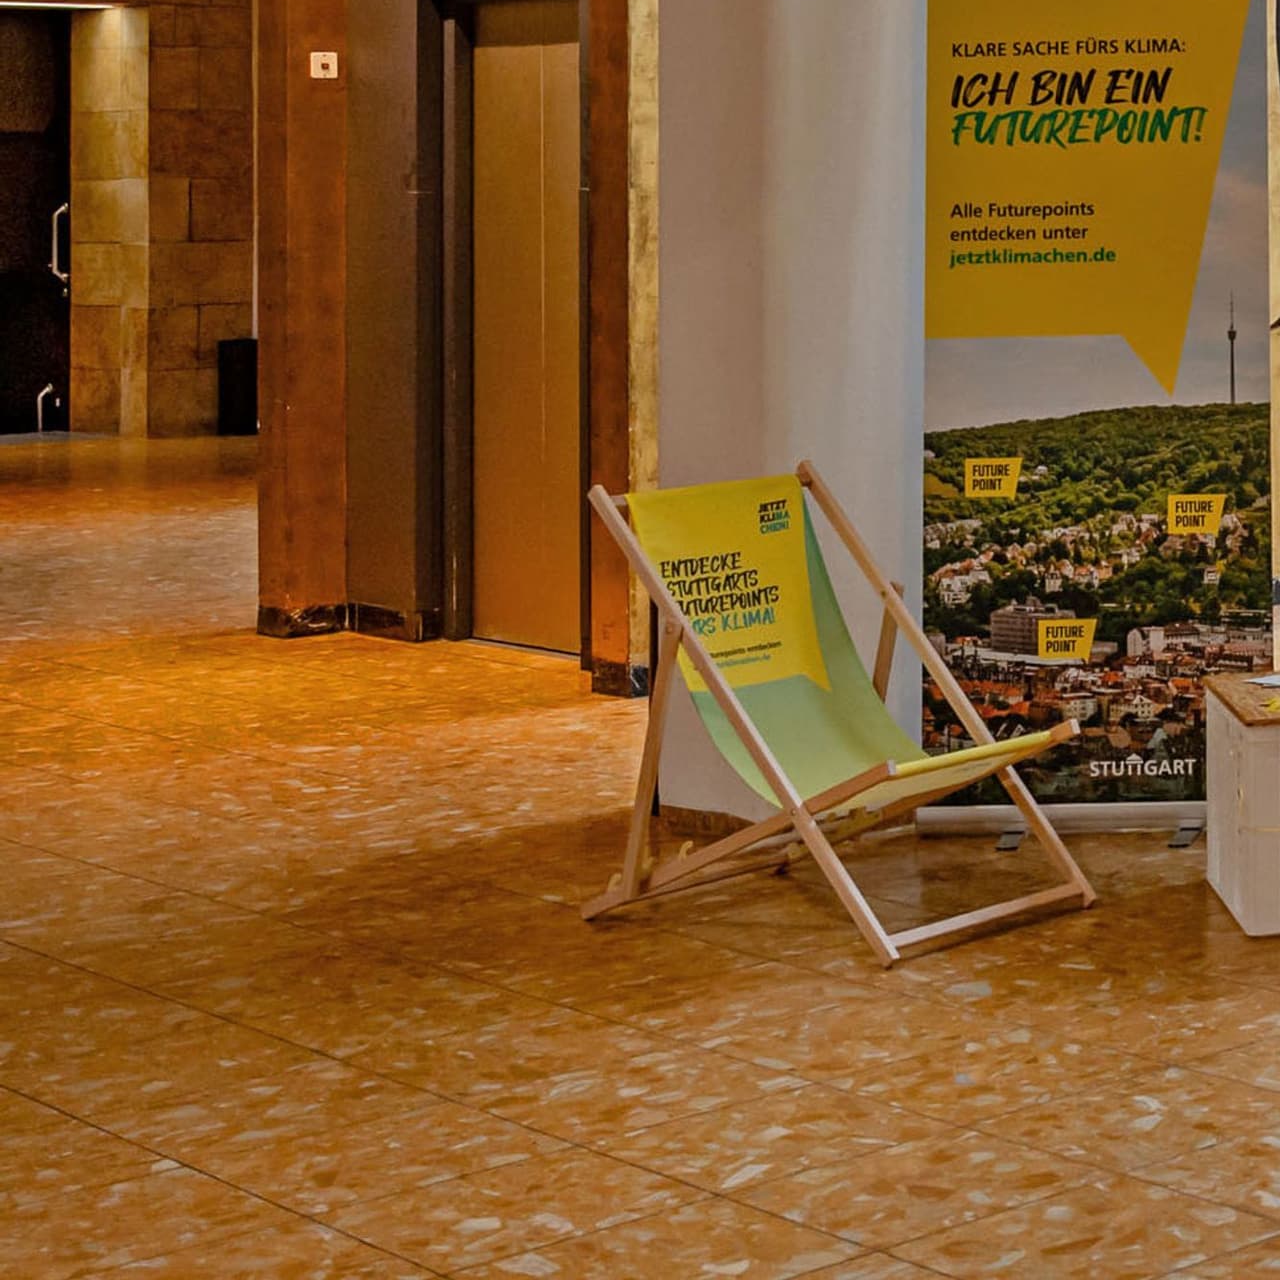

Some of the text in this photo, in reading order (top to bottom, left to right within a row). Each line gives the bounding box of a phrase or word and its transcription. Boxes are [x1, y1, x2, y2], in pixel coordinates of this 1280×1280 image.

[951, 36, 1187, 58] KLARE SACHE FÜRS KLIMA:
[950, 67, 1173, 109] ICH BIN EIN
[950, 106, 1209, 150] FUTUREPOINT!
[950, 200, 1095, 222] Alle Futurepoints
[949, 225, 1089, 243] entdecken unter
[949, 246, 1117, 269] jetztklimachen.de
[971, 463, 1011, 478] FUTURE
[971, 478, 1003, 492] POINT
[1174, 500, 1215, 514] FUTURE
[1174, 515, 1207, 528] POINT
[659, 551, 742, 579] ENTDECKE
[676, 585, 780, 617] UTUREPOINTS
[1045, 625, 1085, 639] FUTURE
[1045, 639, 1078, 654] POINT
[1088, 752, 1198, 778] STUTTGART
